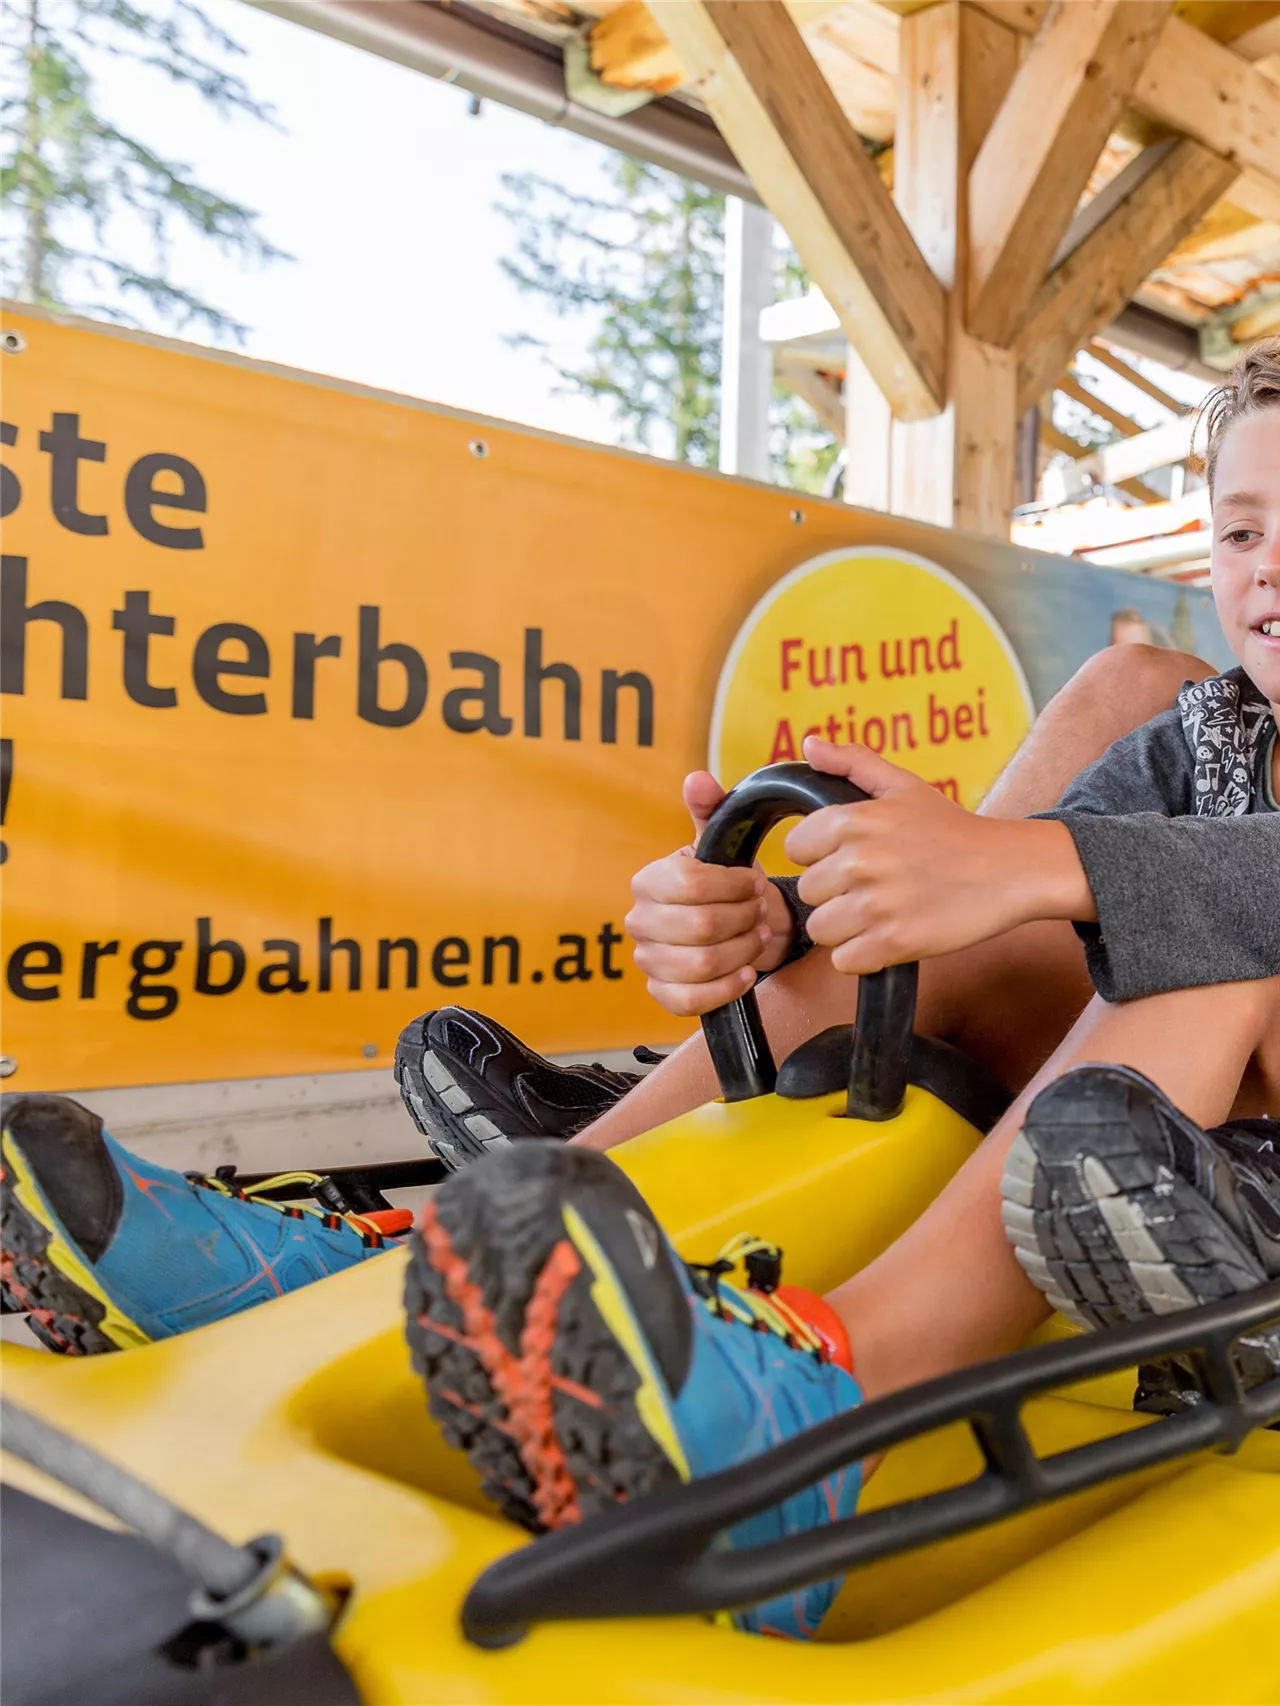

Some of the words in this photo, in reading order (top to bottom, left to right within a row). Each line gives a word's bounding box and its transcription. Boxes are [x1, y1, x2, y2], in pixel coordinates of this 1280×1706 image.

[0, 555, 654, 747] hterbahn
[780, 637, 868, 692] Fun
[880, 618, 962, 680] und
[928, 686, 989, 746] bei
[6, 917, 623, 1021] ergbahnen.at
